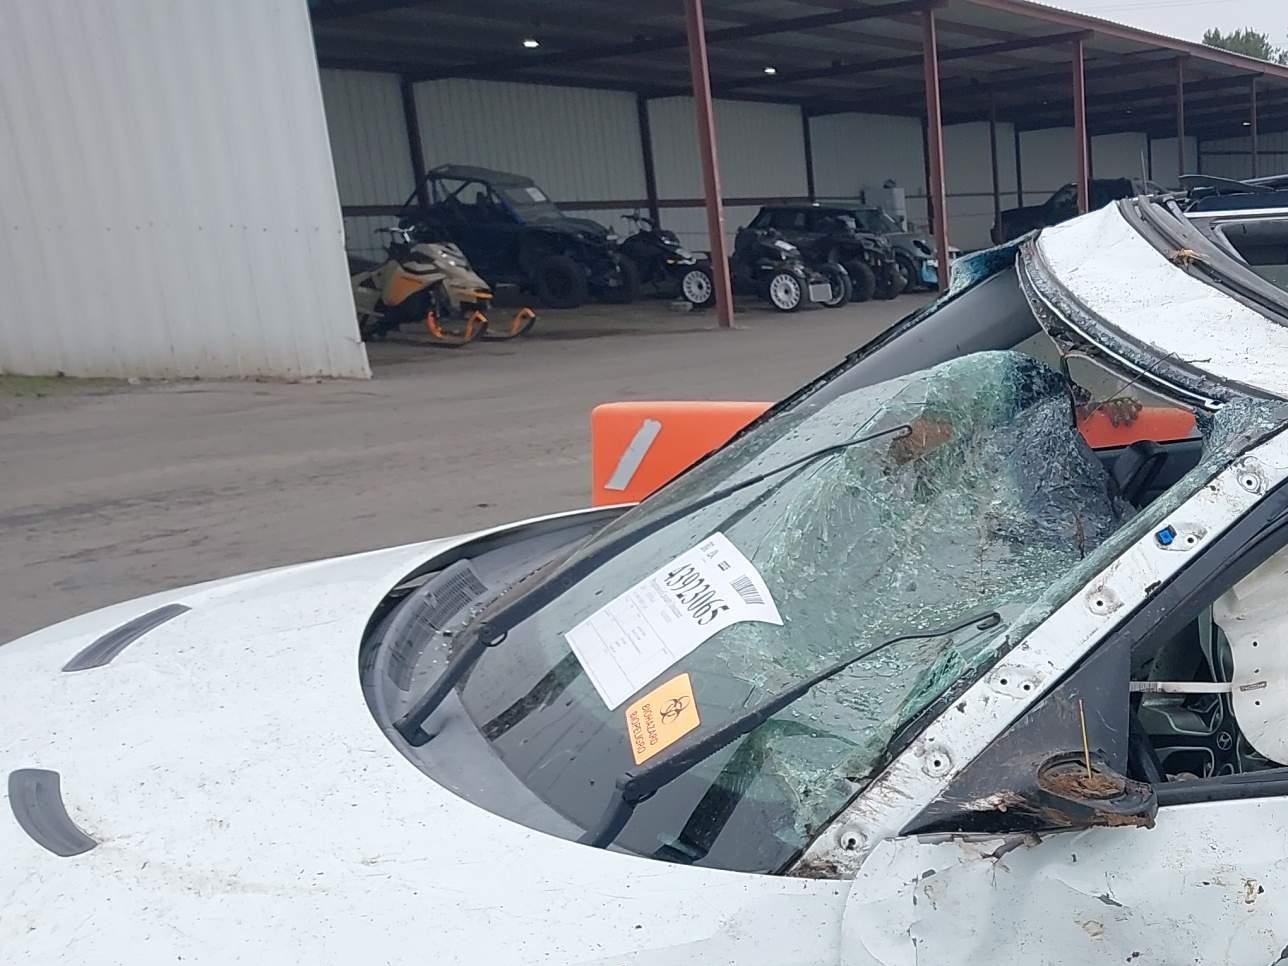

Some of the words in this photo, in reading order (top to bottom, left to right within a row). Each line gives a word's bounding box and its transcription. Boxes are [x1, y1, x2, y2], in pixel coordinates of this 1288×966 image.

[663, 563, 729, 625] 43923065
[630, 710, 647, 754] BIOPELIGRO
[642, 703, 659, 745] BIOHAZARD
